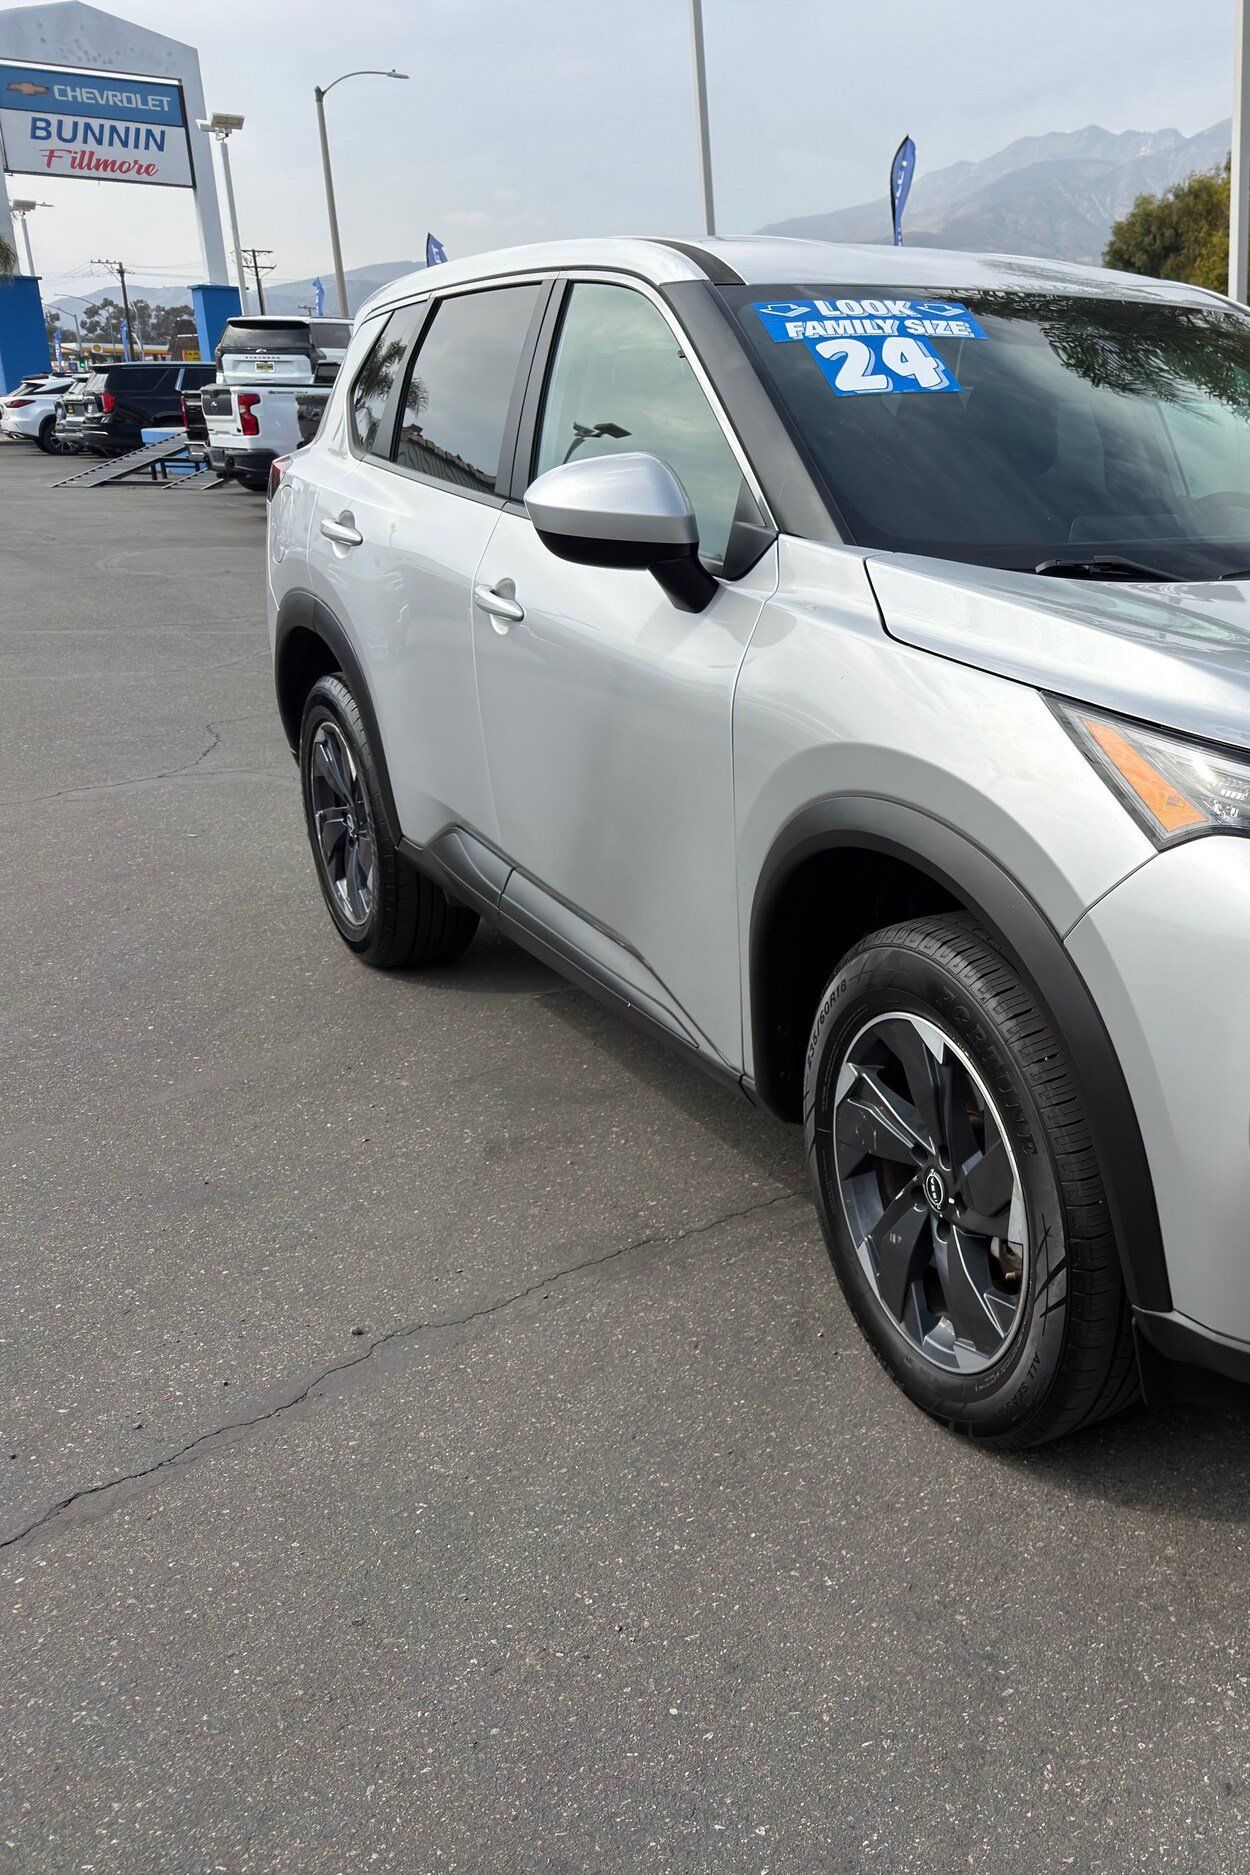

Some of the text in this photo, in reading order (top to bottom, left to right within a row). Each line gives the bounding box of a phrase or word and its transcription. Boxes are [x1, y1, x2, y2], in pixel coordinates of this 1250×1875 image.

[53, 84, 170, 112] CHEVROLET
[30, 116, 166, 152] BUNNIN
[38, 148, 159, 177] Fillmore
[813, 299, 921, 318] LOOK
[784, 318, 975, 339] FAMILY SIZE
[814, 336, 950, 393] 24
